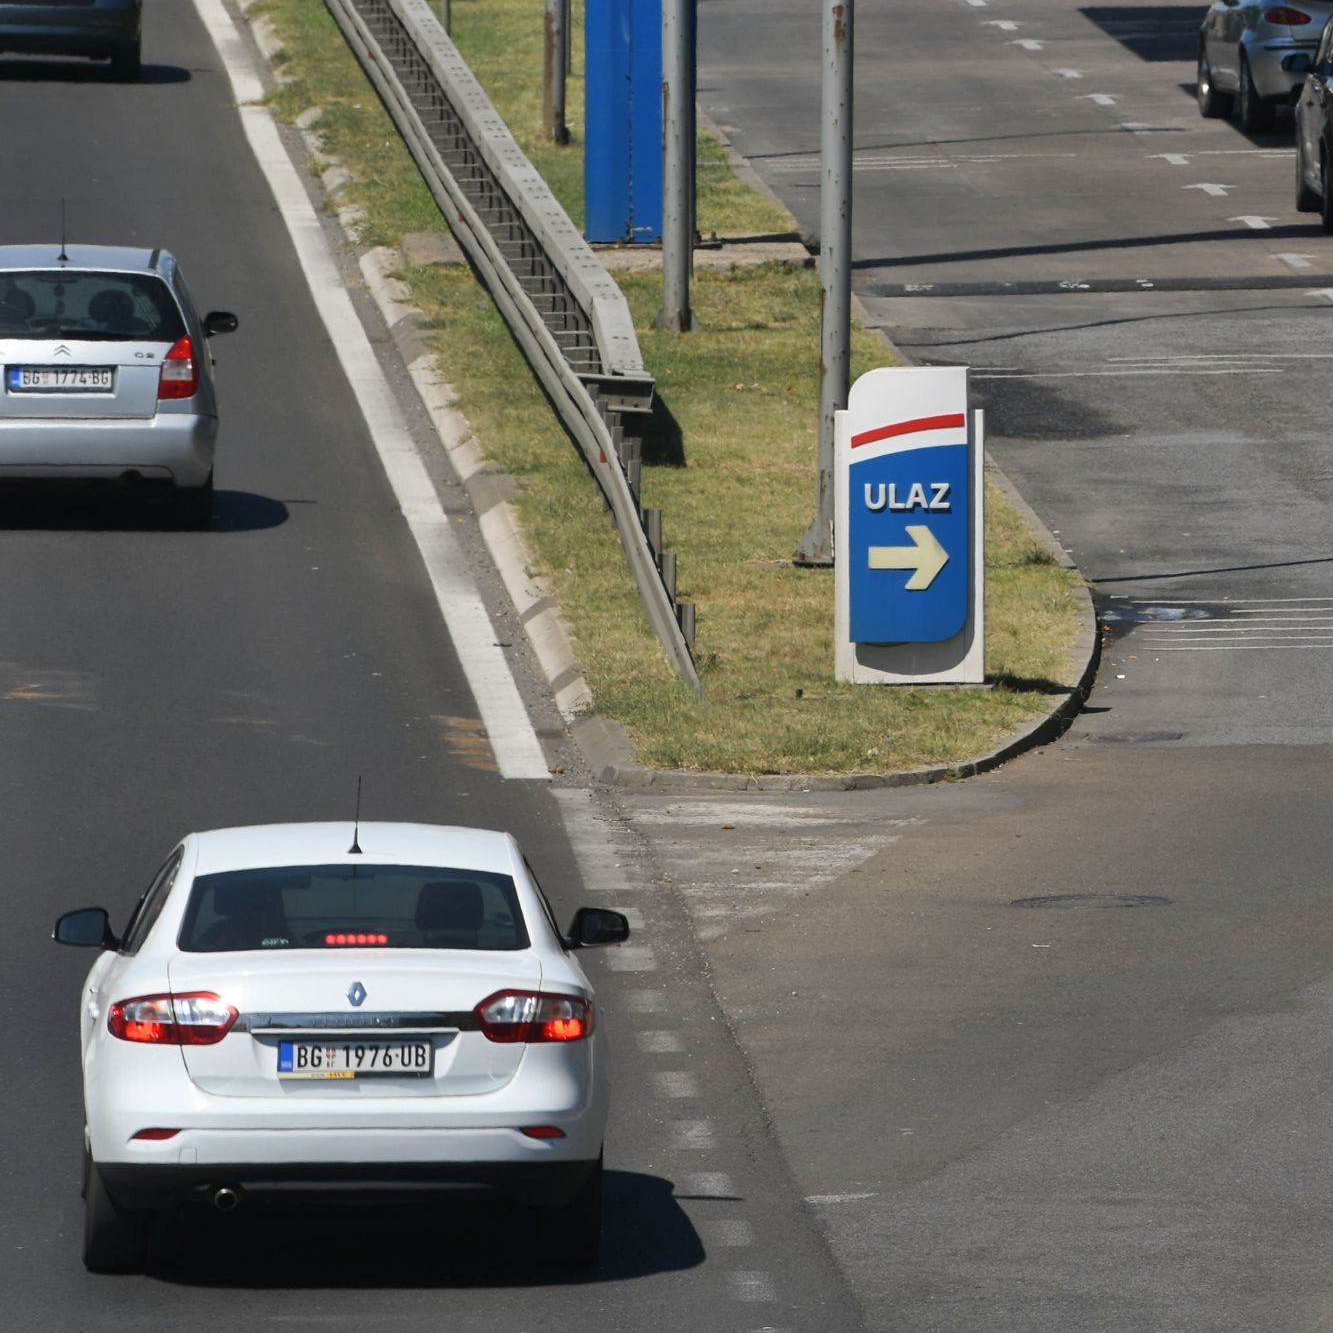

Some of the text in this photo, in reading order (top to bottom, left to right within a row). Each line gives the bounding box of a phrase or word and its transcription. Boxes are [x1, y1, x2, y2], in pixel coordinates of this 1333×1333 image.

[23, 370, 40, 385] BG
[863, 481, 951, 512] ULAZ
[297, 1046, 322, 1068] BG
